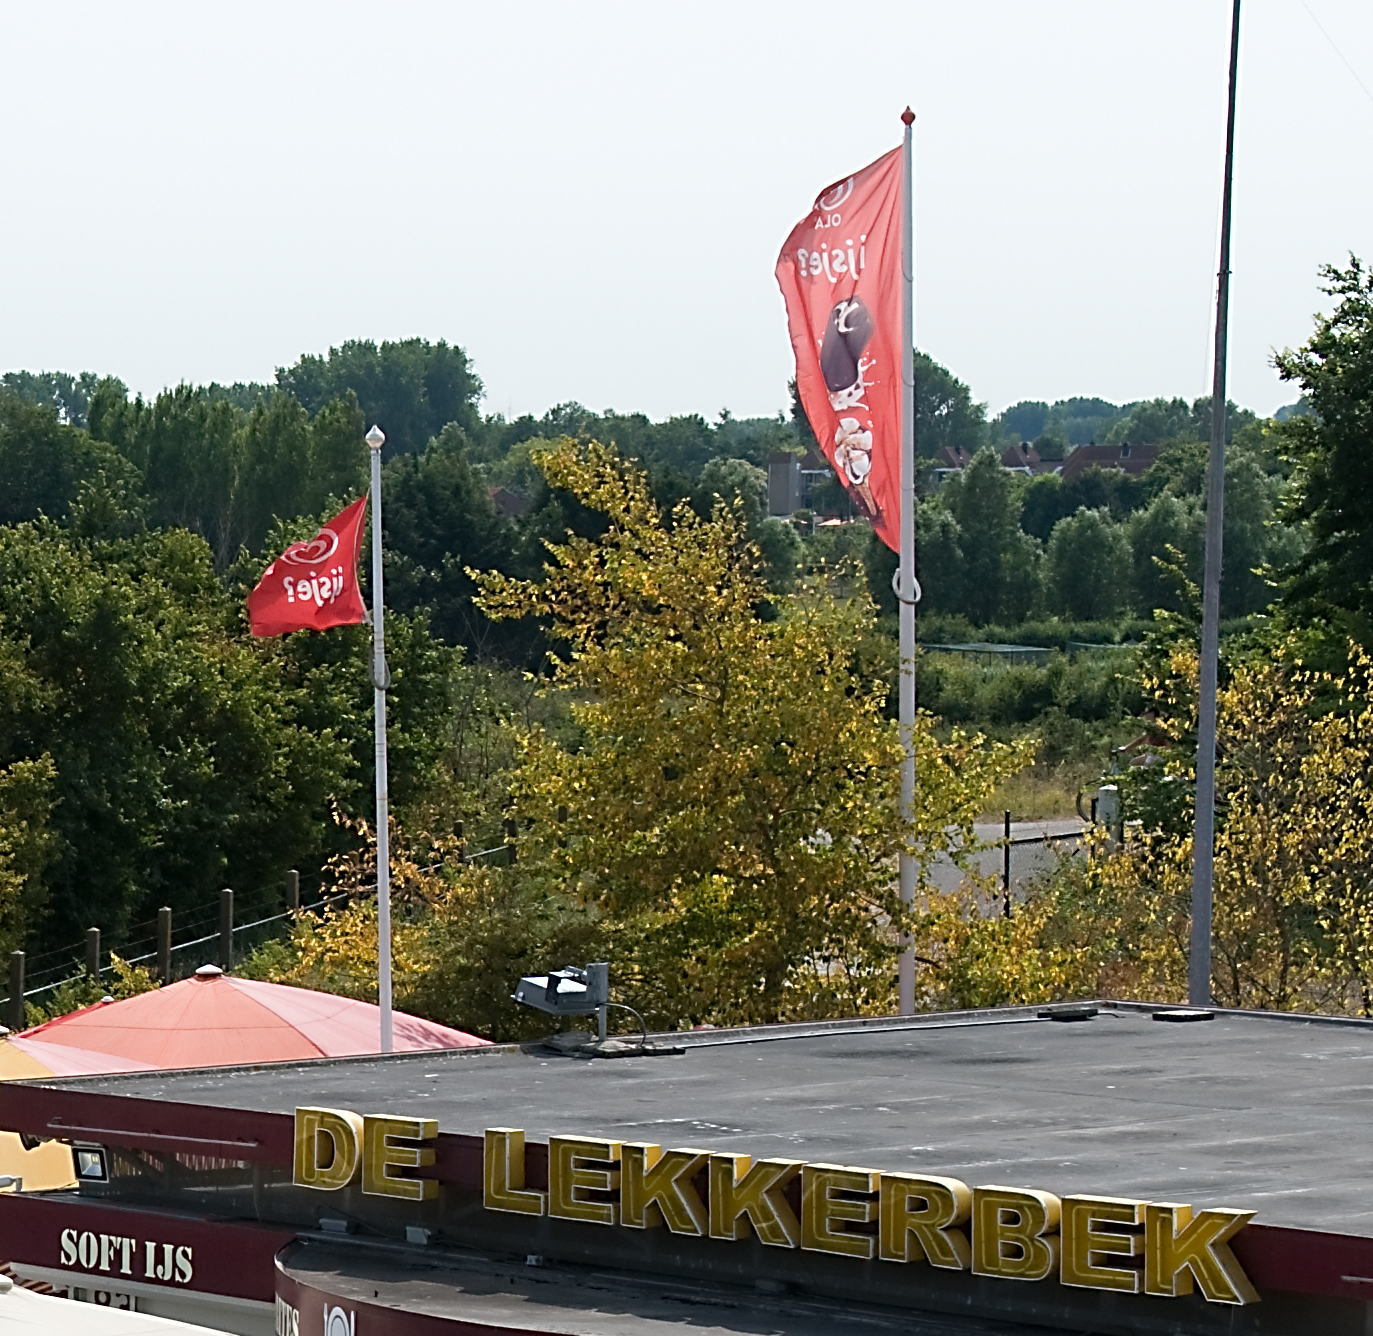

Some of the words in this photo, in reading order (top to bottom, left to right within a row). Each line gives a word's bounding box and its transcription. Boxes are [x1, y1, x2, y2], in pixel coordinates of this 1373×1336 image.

[61, 1228, 136, 1275] SOFT
[145, 1241, 193, 1283] IJS
[294, 1106, 440, 1202] DE
[483, 1127, 1261, 1306] LEKKERBEK
